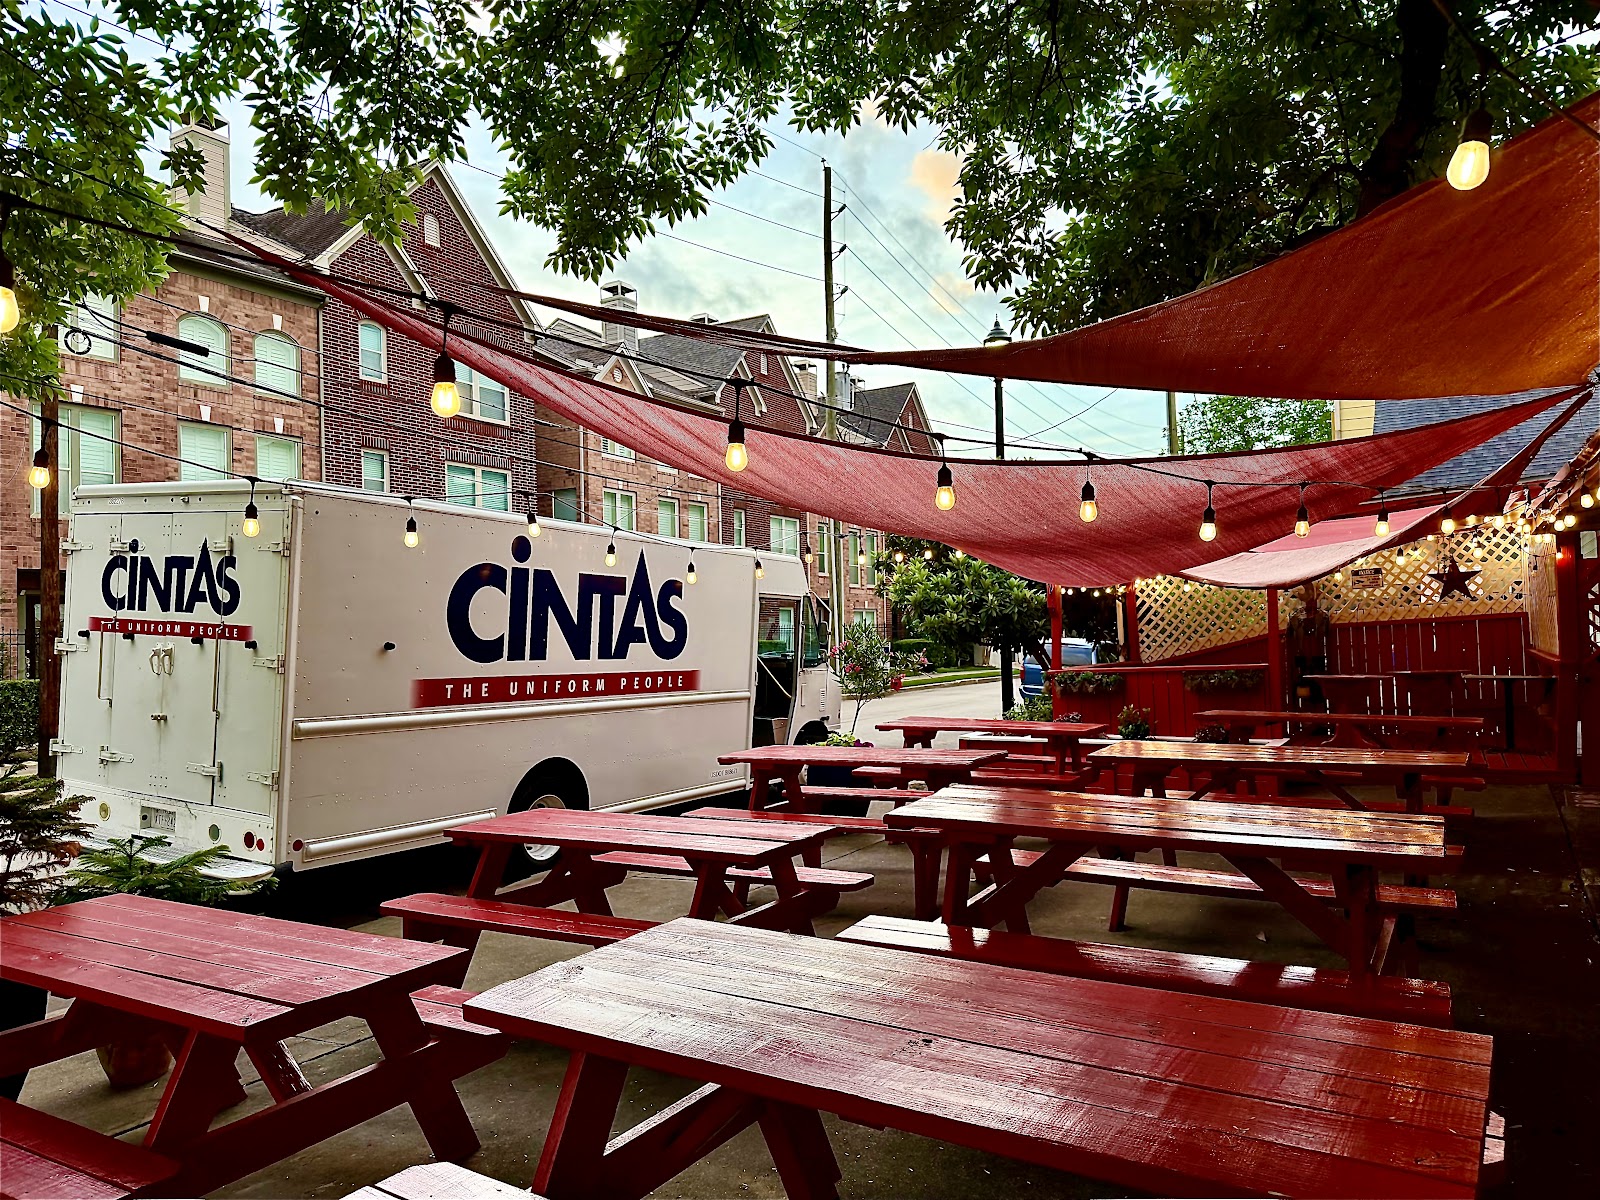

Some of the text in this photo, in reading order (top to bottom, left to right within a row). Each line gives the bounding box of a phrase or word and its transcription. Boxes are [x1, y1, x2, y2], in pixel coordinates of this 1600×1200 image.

[127, 622, 181, 634] UNIFORM
[445, 675, 684, 699] THE UNIFORM PEOPLE
